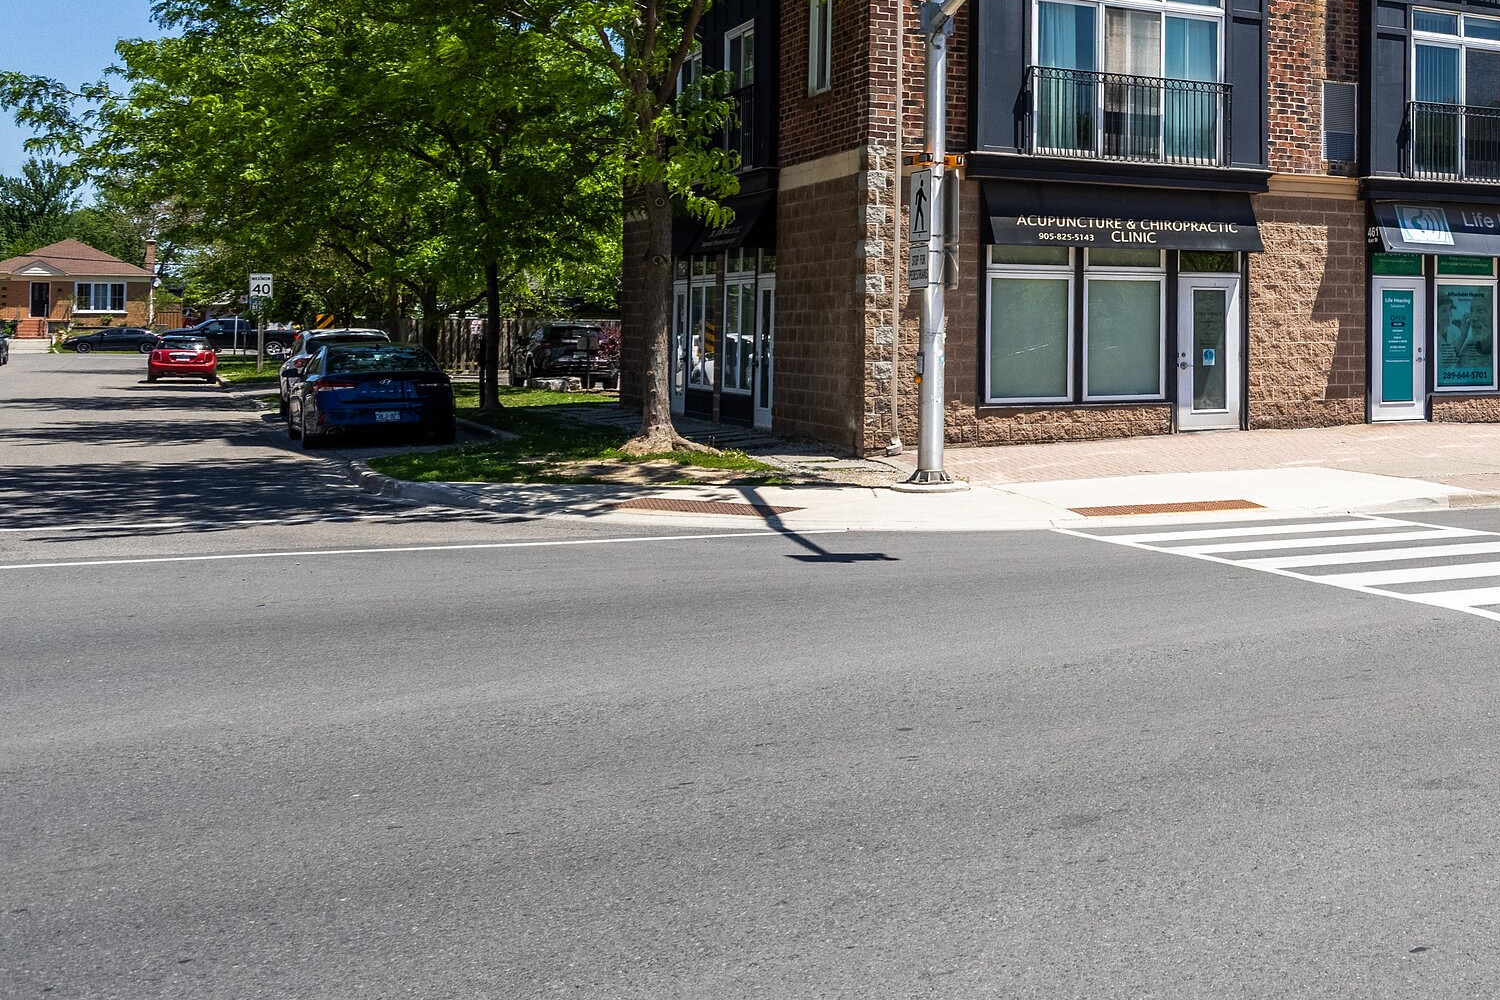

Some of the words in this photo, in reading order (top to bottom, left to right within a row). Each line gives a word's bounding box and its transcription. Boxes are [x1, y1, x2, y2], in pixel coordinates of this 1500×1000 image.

[1016, 214, 1123, 230] ACUPUNCTURE
[1126, 219, 1136, 230] &
[1140, 218, 1239, 234] CHIROPRACTIC
[1461, 211, 1494, 228] Life
[1038, 232, 1095, 242] 905-825-5143
[1111, 231, 1157, 244] CLINIC
[1367, 226, 1379, 238] 461
[909, 268, 928, 281] PEDESTRIANS
[252, 283, 271, 295] 40
[1442, 371, 1488, 380] 289-644-5701
